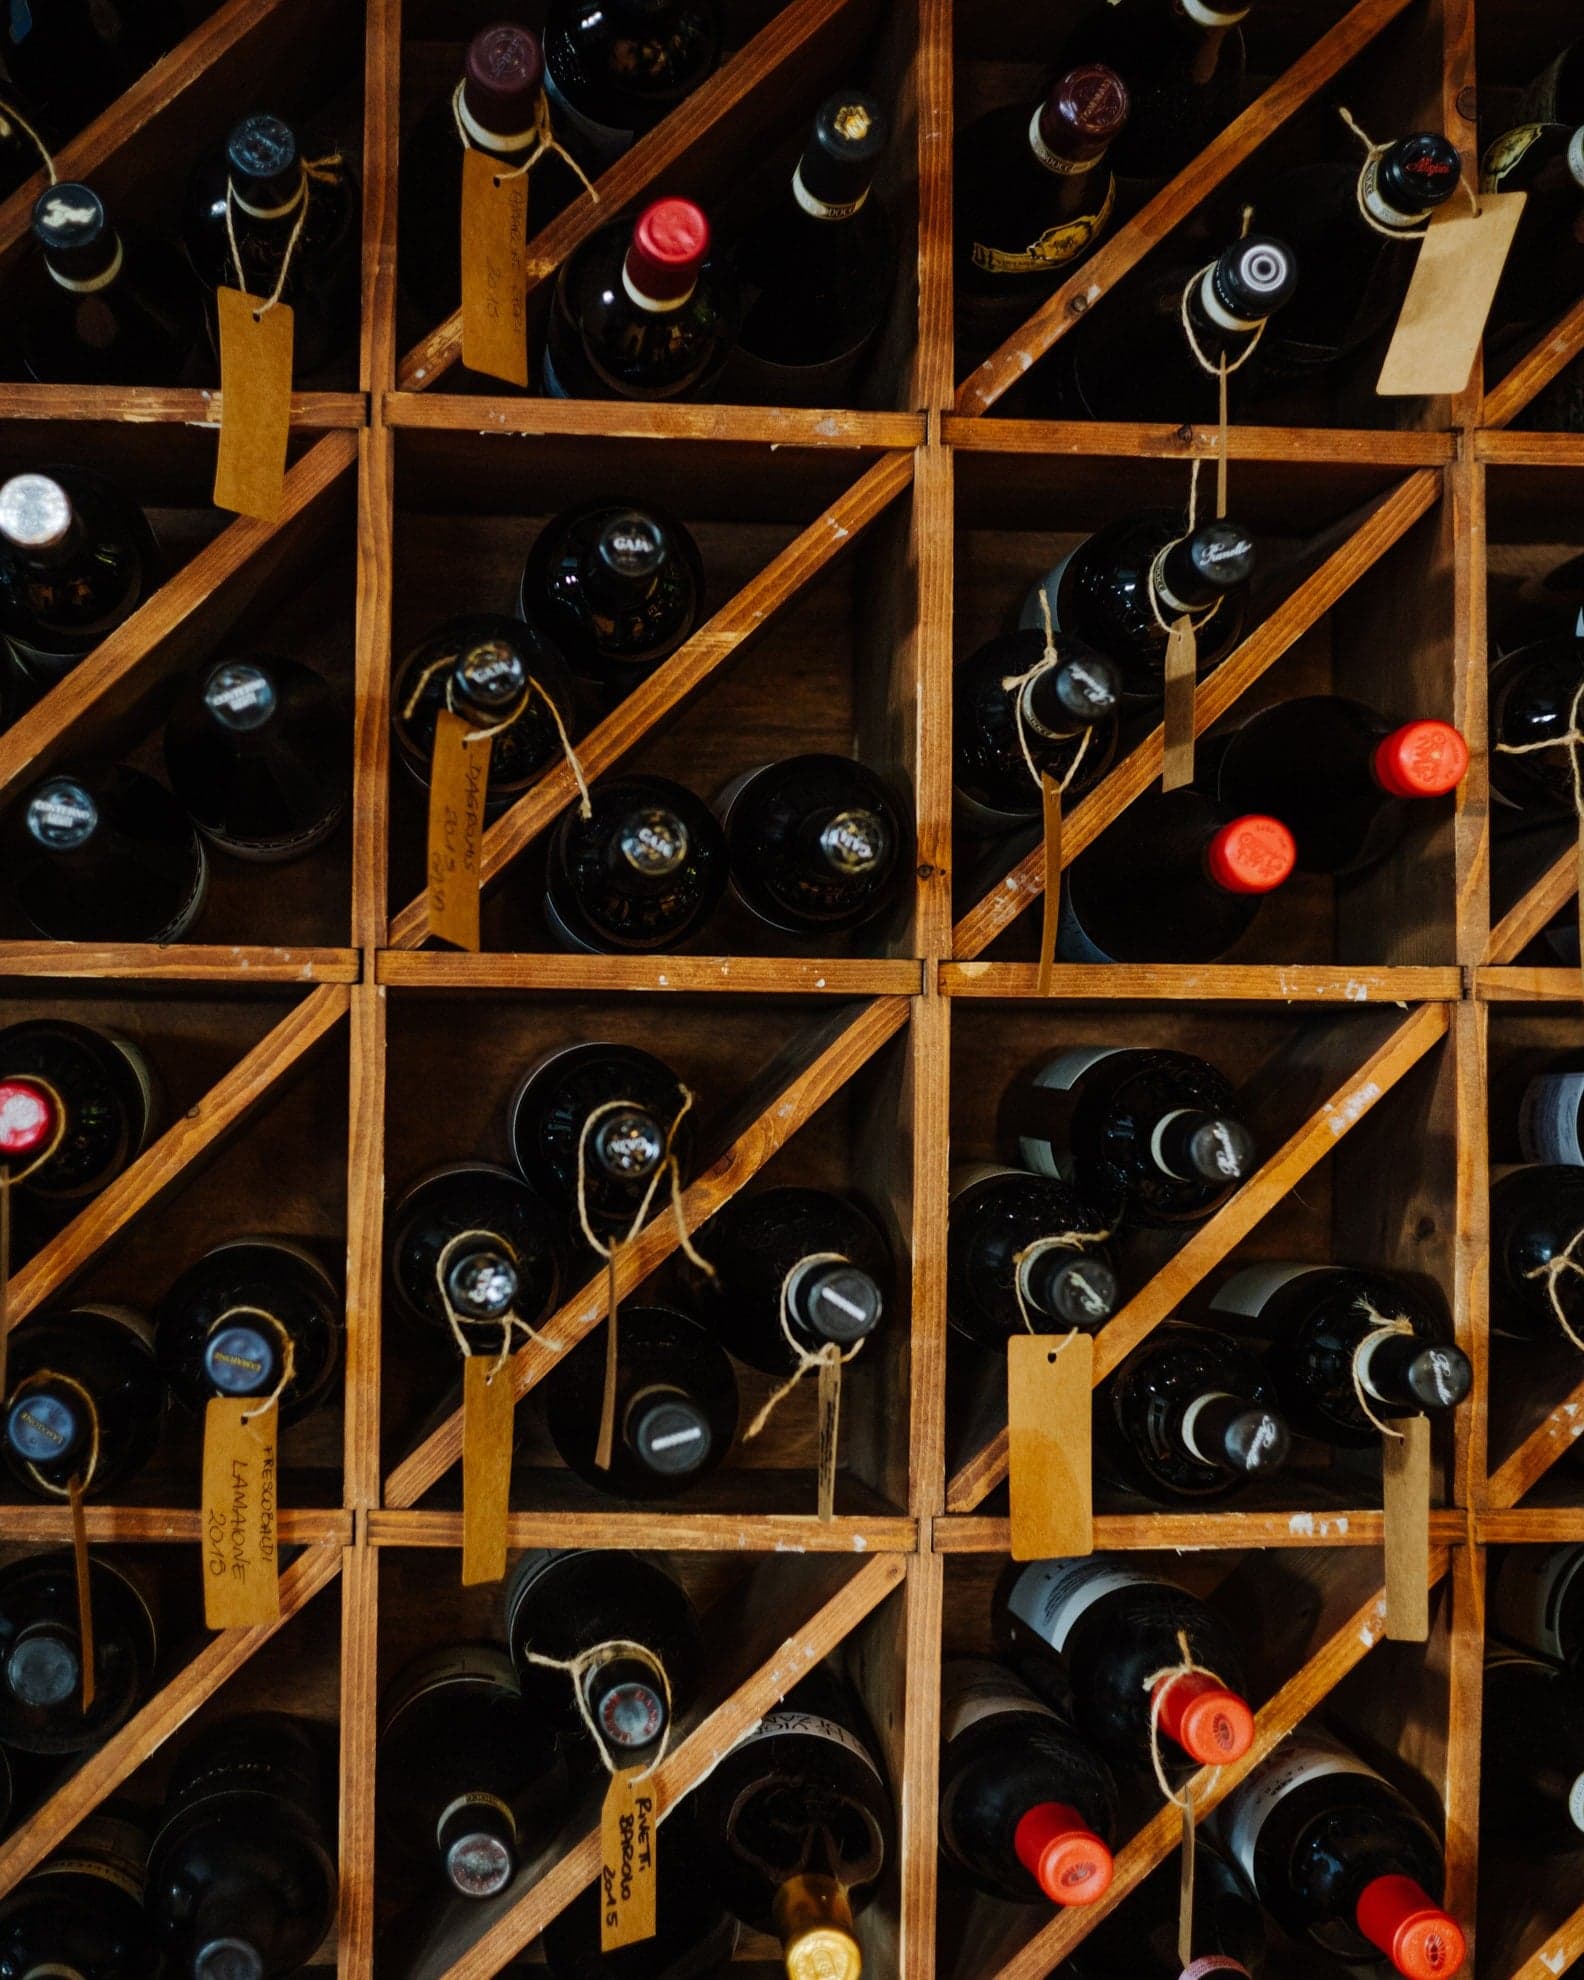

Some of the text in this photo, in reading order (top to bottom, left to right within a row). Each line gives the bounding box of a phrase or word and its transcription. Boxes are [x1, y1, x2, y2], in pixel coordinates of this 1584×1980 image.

[612, 535, 655, 555] GAJA
[208, 1509, 226, 1576] 2015
[230, 1459, 251, 1584] LAMAIONE
[259, 1445, 274, 1563] FRESCOBALDI
[618, 1813, 634, 1900] BAROLO
[603, 1864, 618, 1928] 2015
